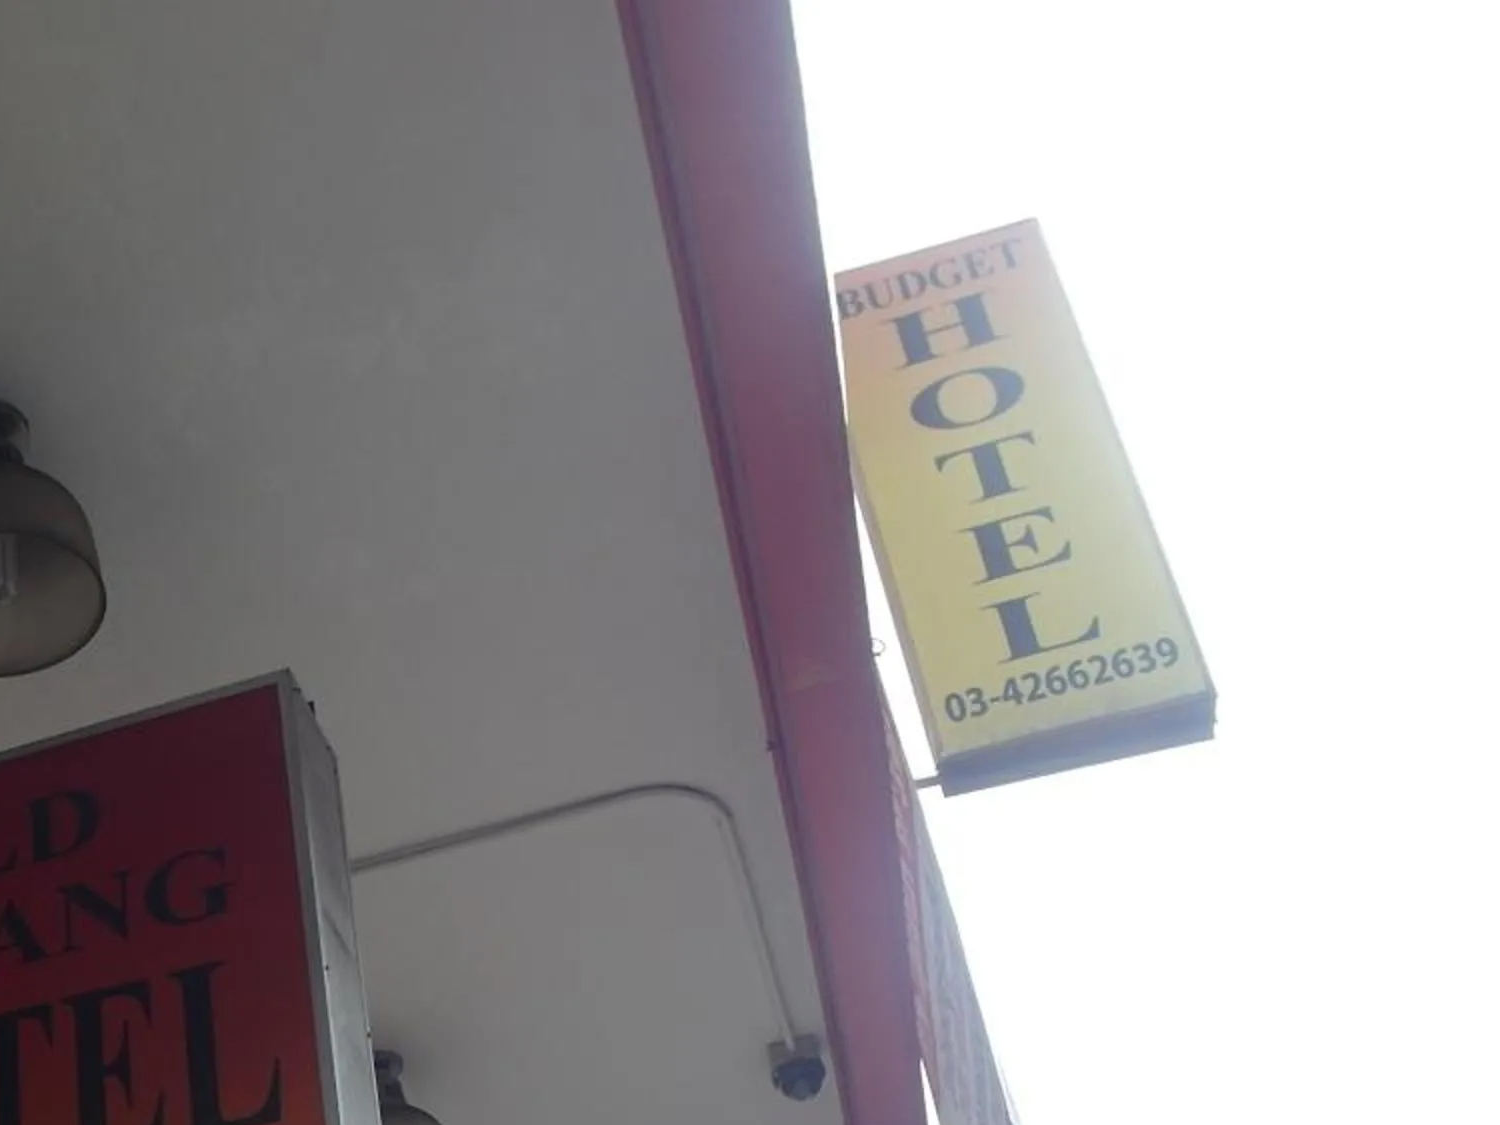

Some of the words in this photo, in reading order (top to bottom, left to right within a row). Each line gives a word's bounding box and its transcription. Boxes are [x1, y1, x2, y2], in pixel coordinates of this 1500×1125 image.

[835, 239, 1021, 320] BUDGET
[879, 290, 1100, 666] HOTEL
[943, 636, 1180, 723] 03-42662639
